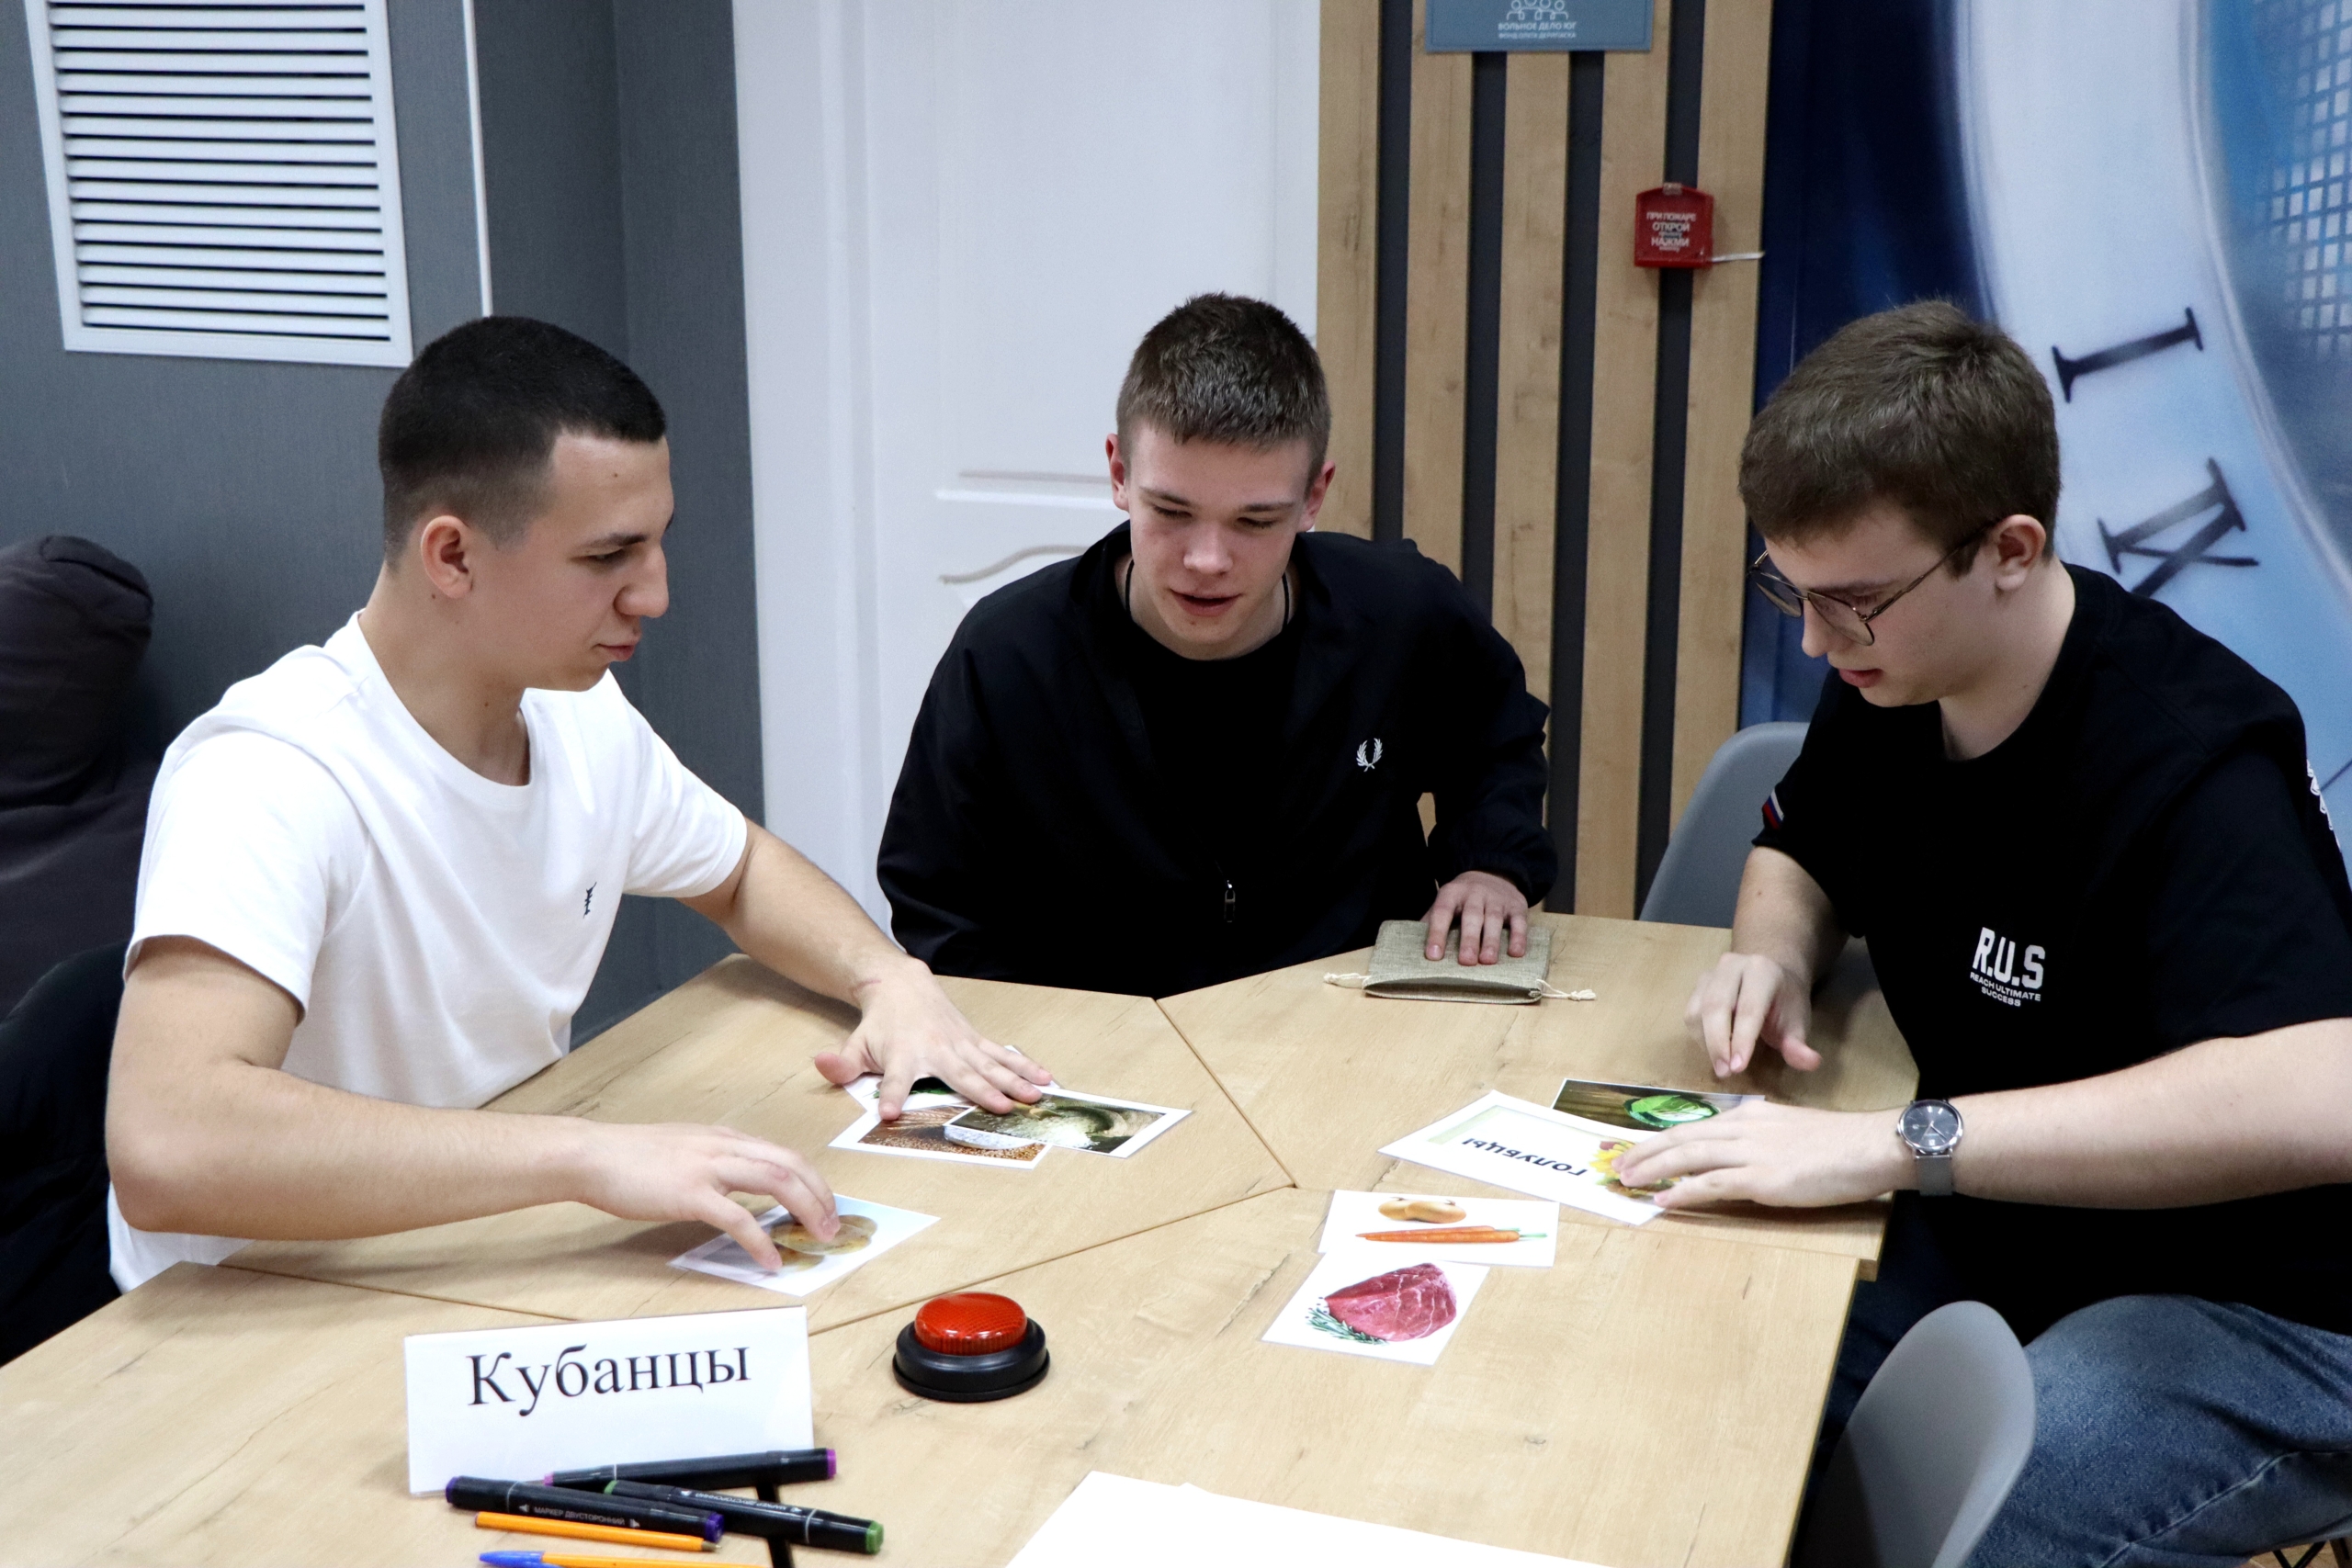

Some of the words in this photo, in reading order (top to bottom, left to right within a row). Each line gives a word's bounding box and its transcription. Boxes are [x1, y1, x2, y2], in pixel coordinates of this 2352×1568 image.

[1498, 22, 1537, 31] ВОЛЬНОЕ
[1538, 22, 1562, 31] ДЕЛО
[1646, 211, 1662, 220] ПРИ
[1663, 212, 1696, 221] ПОЖАРЕ
[1652, 221, 1690, 231] ОТКРОЙ
[1651, 237, 1690, 247] НАЖМИ
[1972, 926, 2046, 989] R.U.S
[1970, 971, 1996, 989] REACH
[1996, 983, 2041, 1001] ULTIMATE
[1981, 986, 2021, 1007] SUCCESS
[1462, 1138, 1588, 1176] ГОЛУБЦЫ
[466, 1343, 752, 1417] Кубанцы
[534, 1506, 564, 1517] МАРКЕР
[564, 1510, 626, 1525] ДВУСТОРОННИЙ
